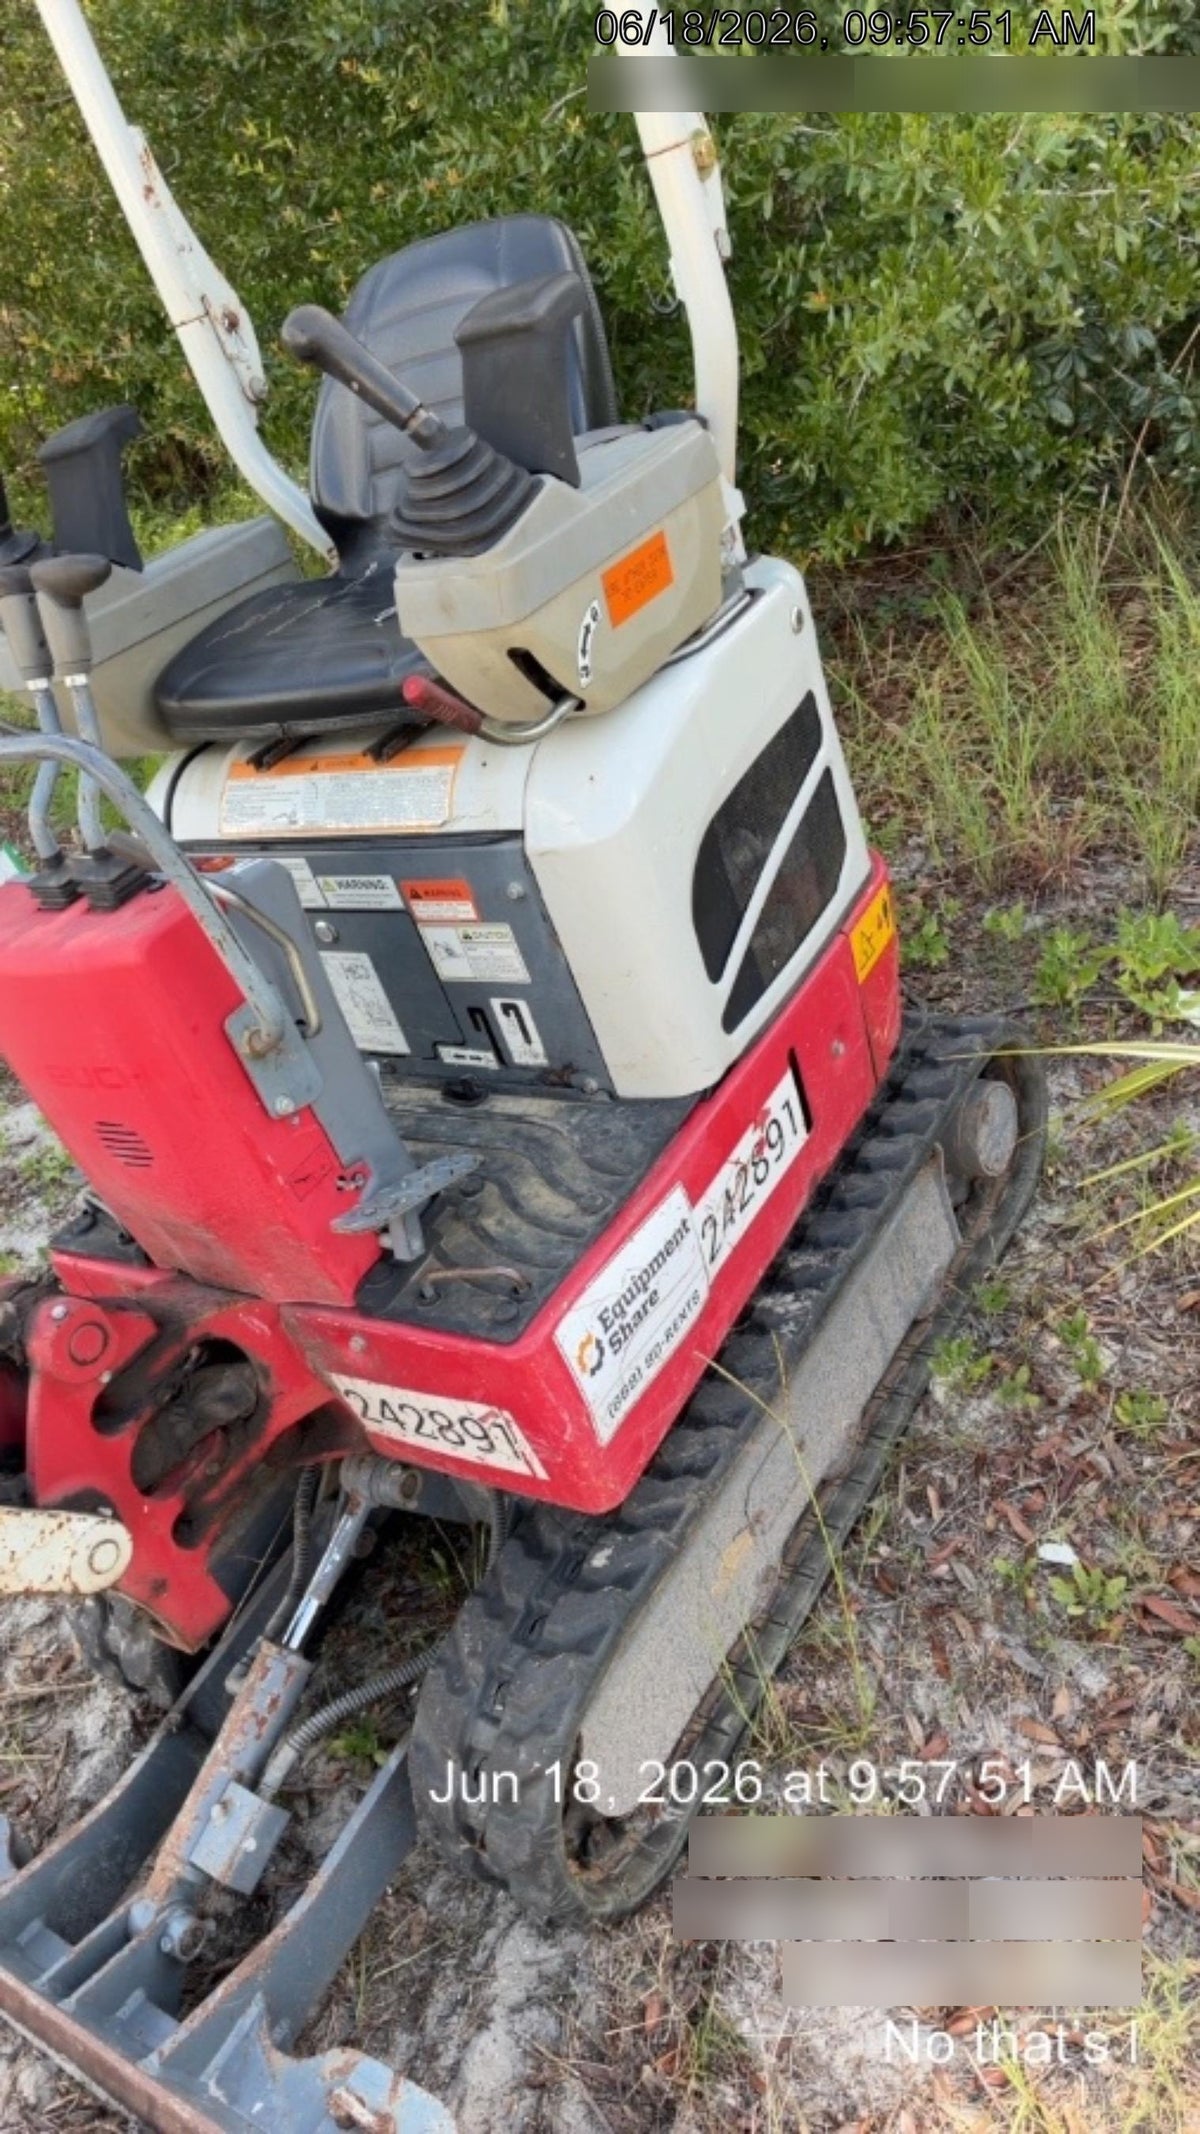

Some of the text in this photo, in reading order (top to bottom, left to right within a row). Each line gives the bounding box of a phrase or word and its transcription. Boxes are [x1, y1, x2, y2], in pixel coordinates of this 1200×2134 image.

[701, 1099, 798, 1265] 242891
[597, 1216, 692, 1335] Equipment
[609, 1288, 660, 1356] Share
[343, 1388, 522, 1461] 242891
